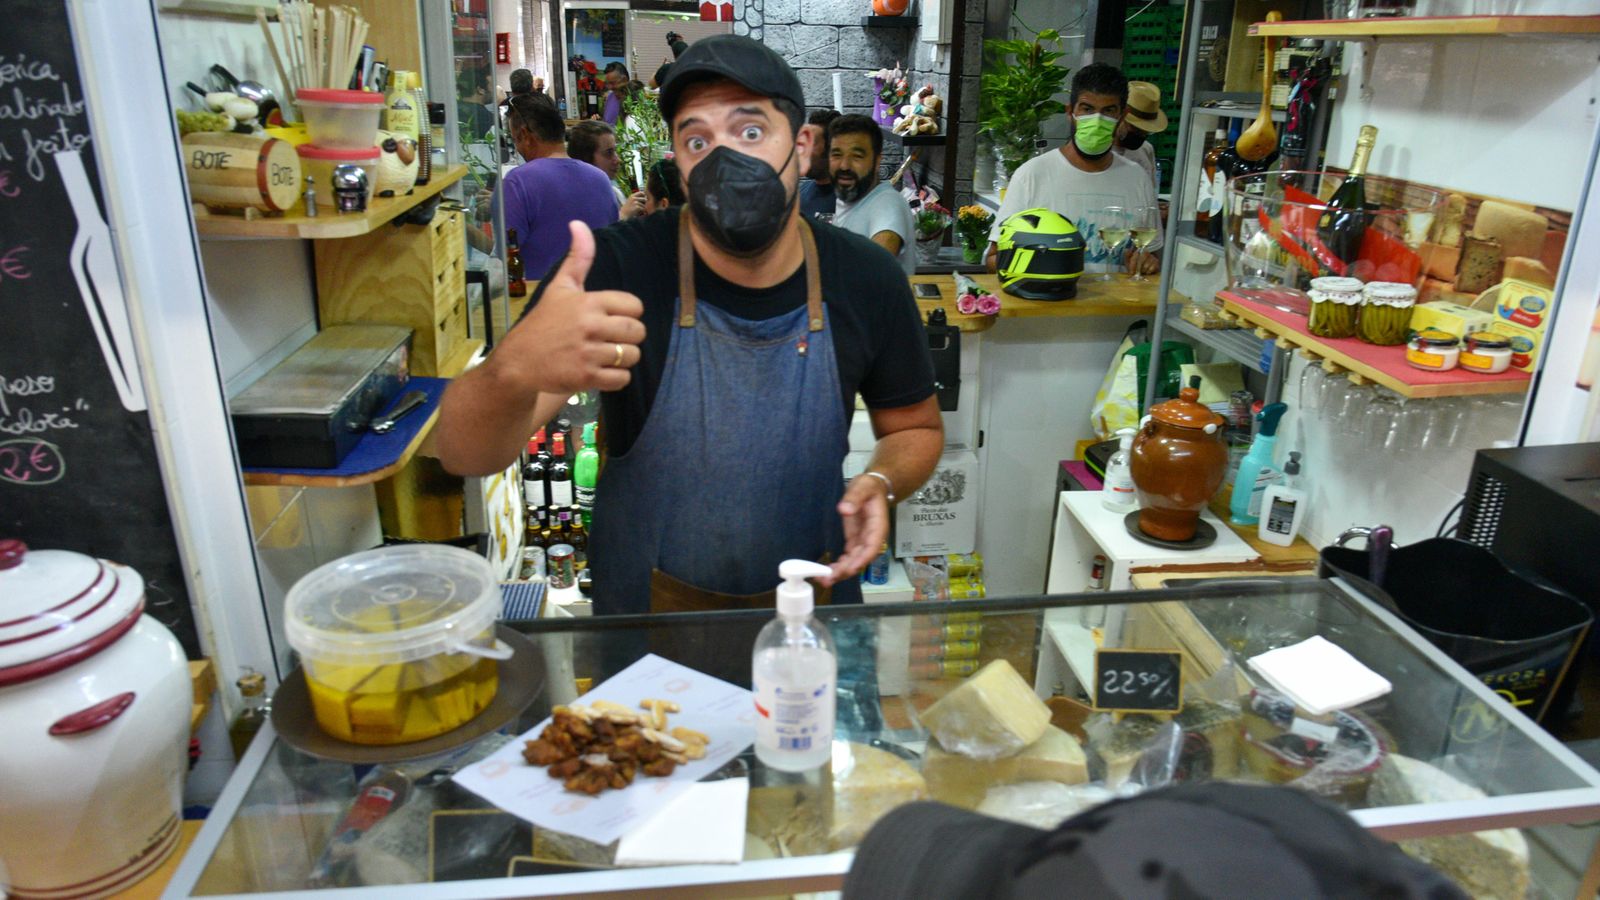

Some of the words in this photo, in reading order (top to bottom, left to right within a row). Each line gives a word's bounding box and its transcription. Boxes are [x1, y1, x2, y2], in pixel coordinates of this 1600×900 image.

[192, 150, 232, 169] BOTE
[272, 163, 294, 186] BOTE
[913, 512, 956, 521] BRUXAS
